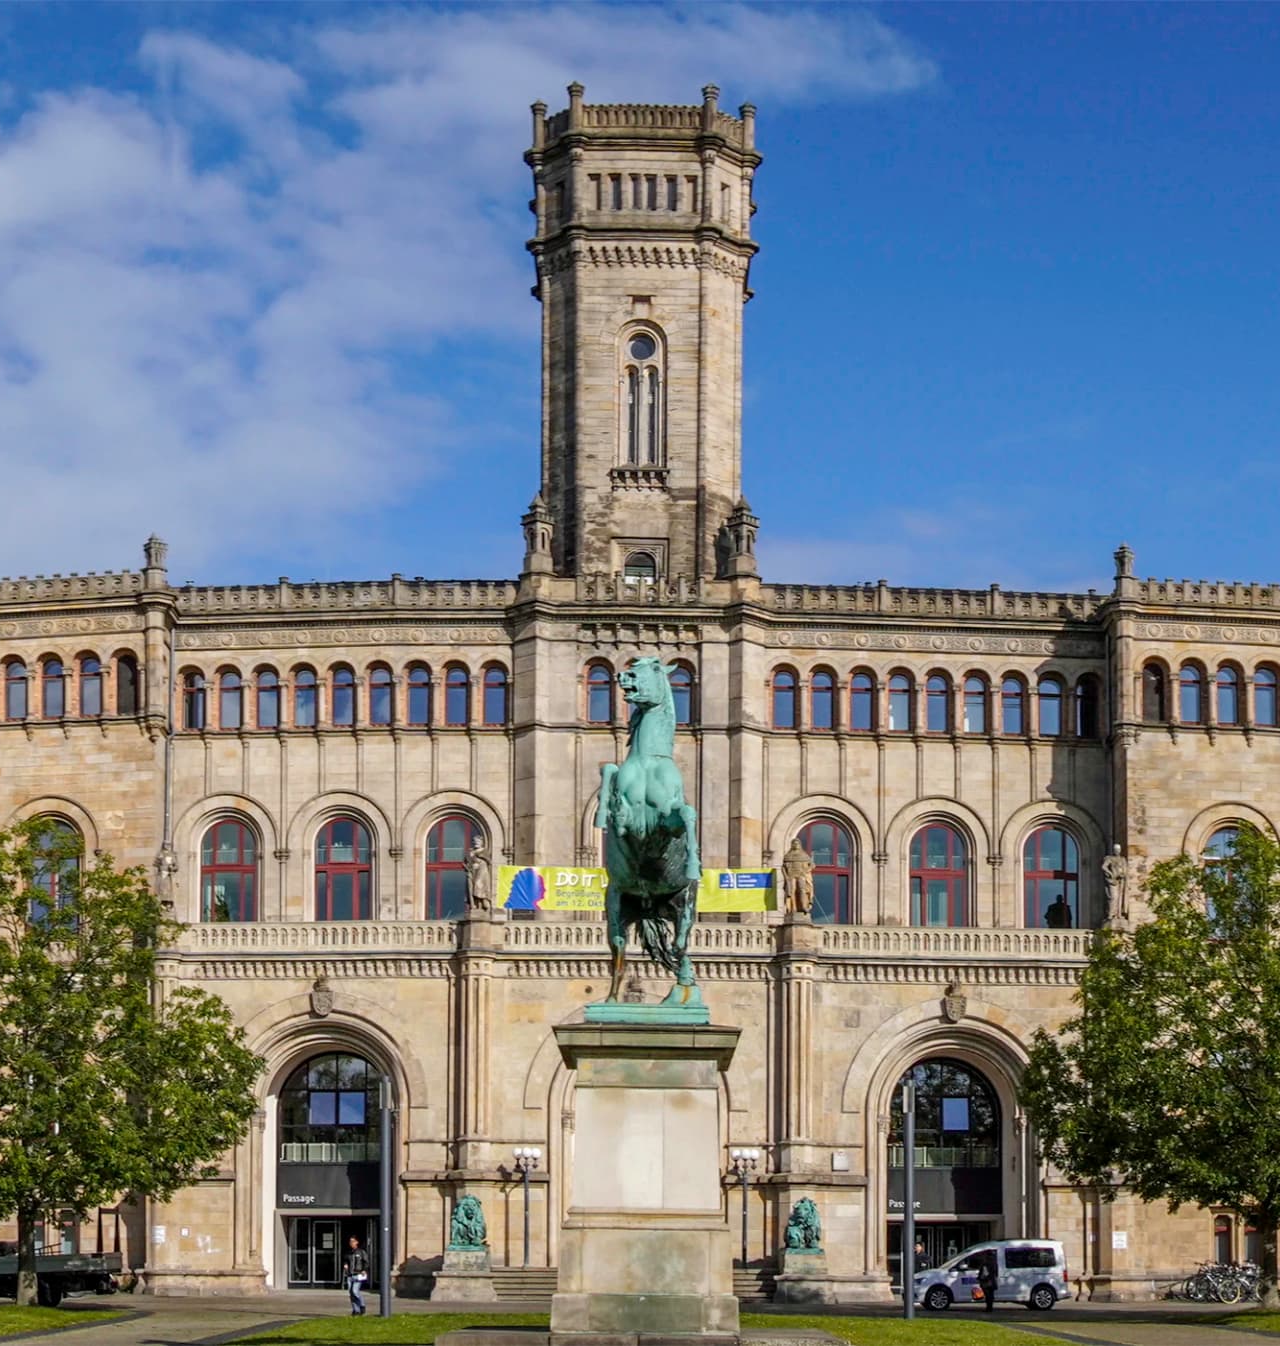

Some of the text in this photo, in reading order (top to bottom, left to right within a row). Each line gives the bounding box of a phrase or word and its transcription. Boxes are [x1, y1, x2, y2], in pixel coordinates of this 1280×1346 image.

[555, 872, 579, 887] DO
[581, 874, 598, 887] IT
[282, 1193, 316, 1205] Passage
[888, 1199, 921, 1209] Pasge
